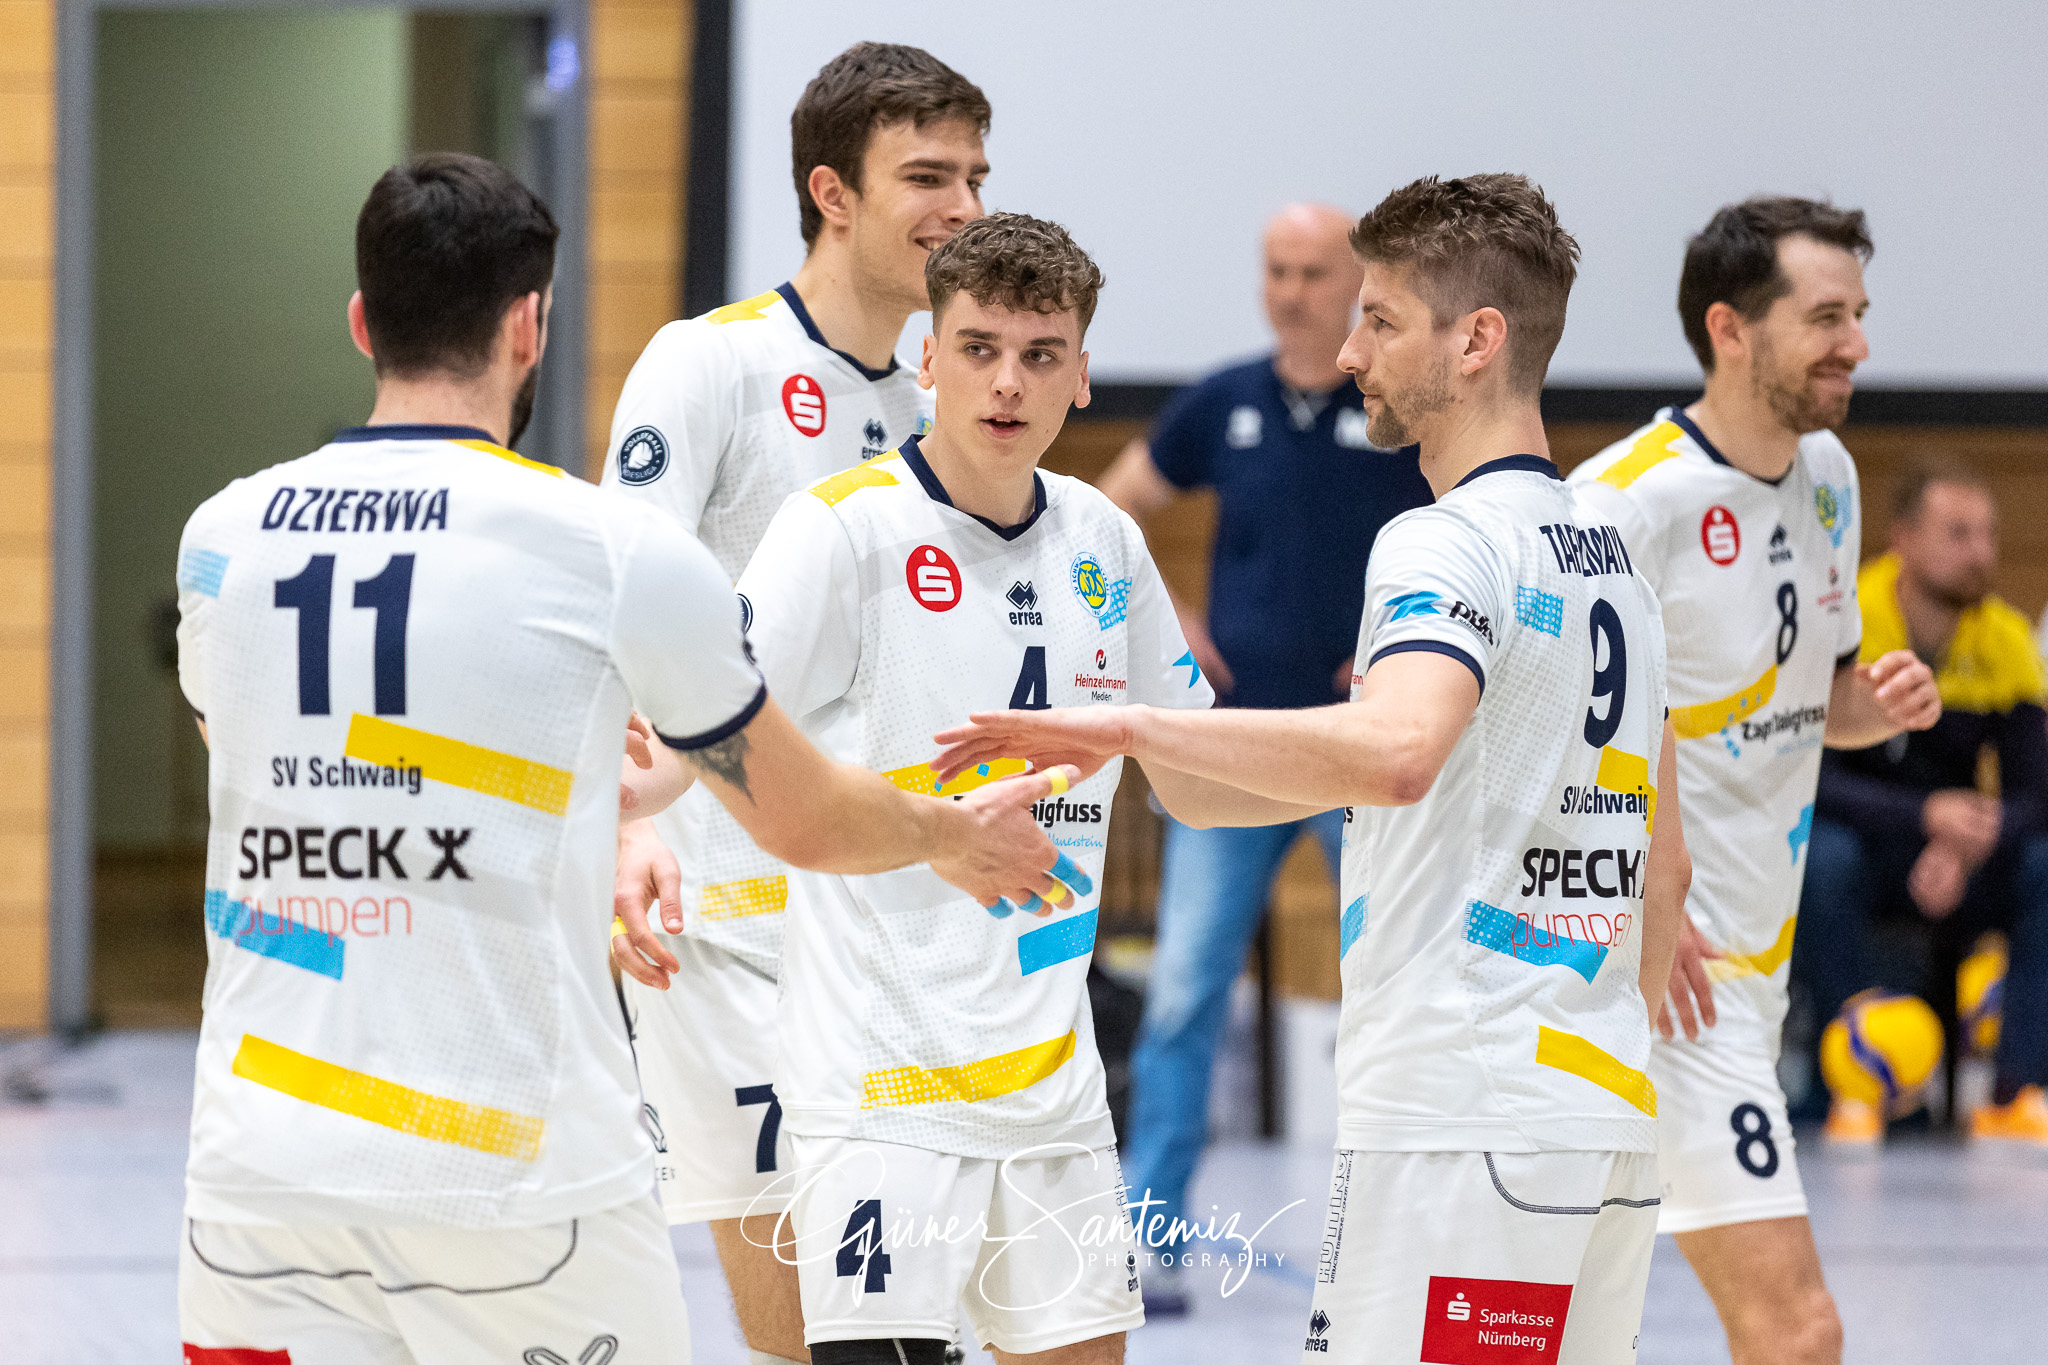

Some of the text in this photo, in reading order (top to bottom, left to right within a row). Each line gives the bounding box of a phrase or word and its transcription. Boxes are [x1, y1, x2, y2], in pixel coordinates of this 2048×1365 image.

[261, 486, 450, 532] DZIERWA
[273, 552, 416, 717] 11
[1777, 581, 1798, 666] 8
[1008, 645, 1052, 711] 4
[1074, 673, 1127, 690] Heinzelmann
[1091, 690, 1113, 702] Medien
[1584, 597, 1628, 749] 9
[272, 756, 422, 795] SV Schwaig
[239, 826, 409, 881] SPECK
[1521, 847, 1641, 899] SPECK
[236, 896, 412, 947] pumpen
[1511, 912, 1633, 958] pumpen
[735, 1083, 782, 1173] 7
[1730, 1101, 1779, 1180] 8
[835, 1199, 892, 1294] 4
[1478, 1330, 1546, 1352] Nürnberg
[1479, 1308, 1554, 1328] Sparkasse
